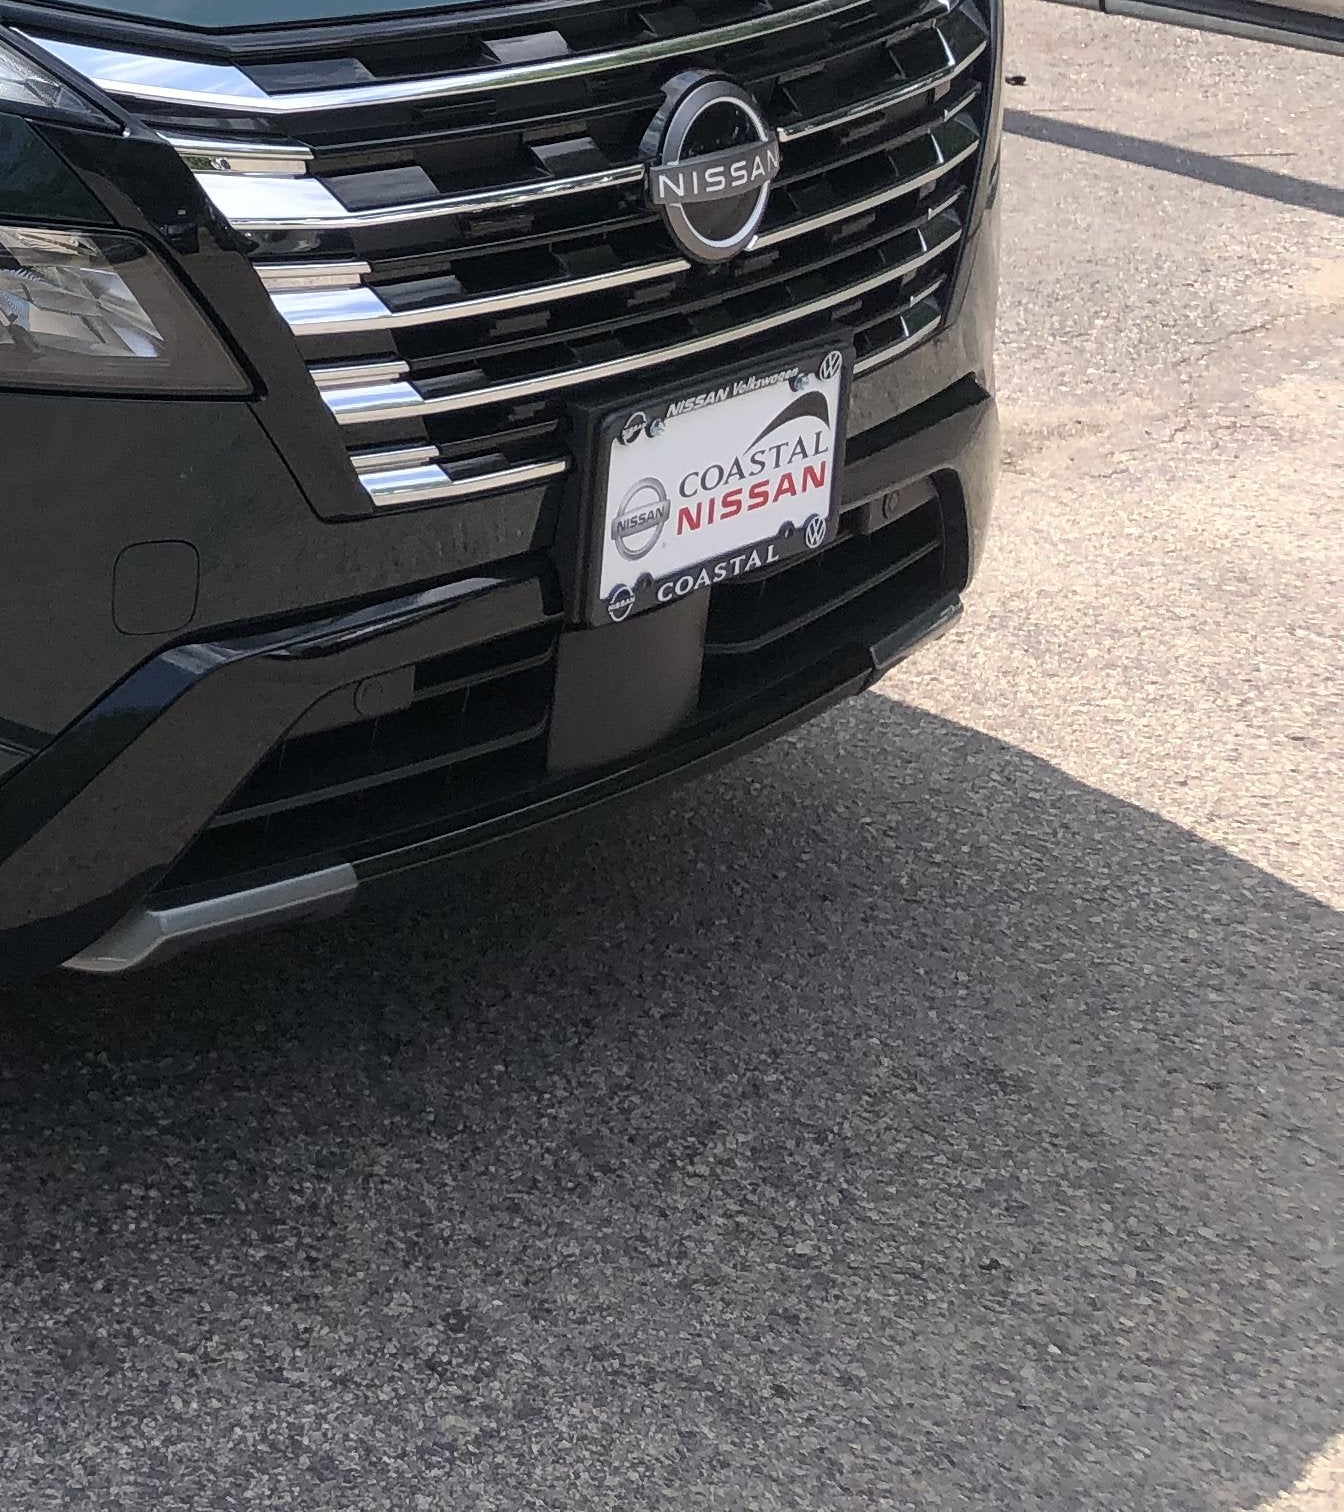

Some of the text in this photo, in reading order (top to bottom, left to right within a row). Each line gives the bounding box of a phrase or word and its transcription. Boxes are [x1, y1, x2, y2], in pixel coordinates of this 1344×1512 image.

[658, 145, 780, 198] NISSAN
[666, 367, 800, 418] NISSAN Volkswagen
[678, 430, 830, 499] COASTAL
[616, 505, 665, 533] NISSAN
[676, 461, 827, 537] NISSAN
[657, 544, 780, 603] COASTAL
